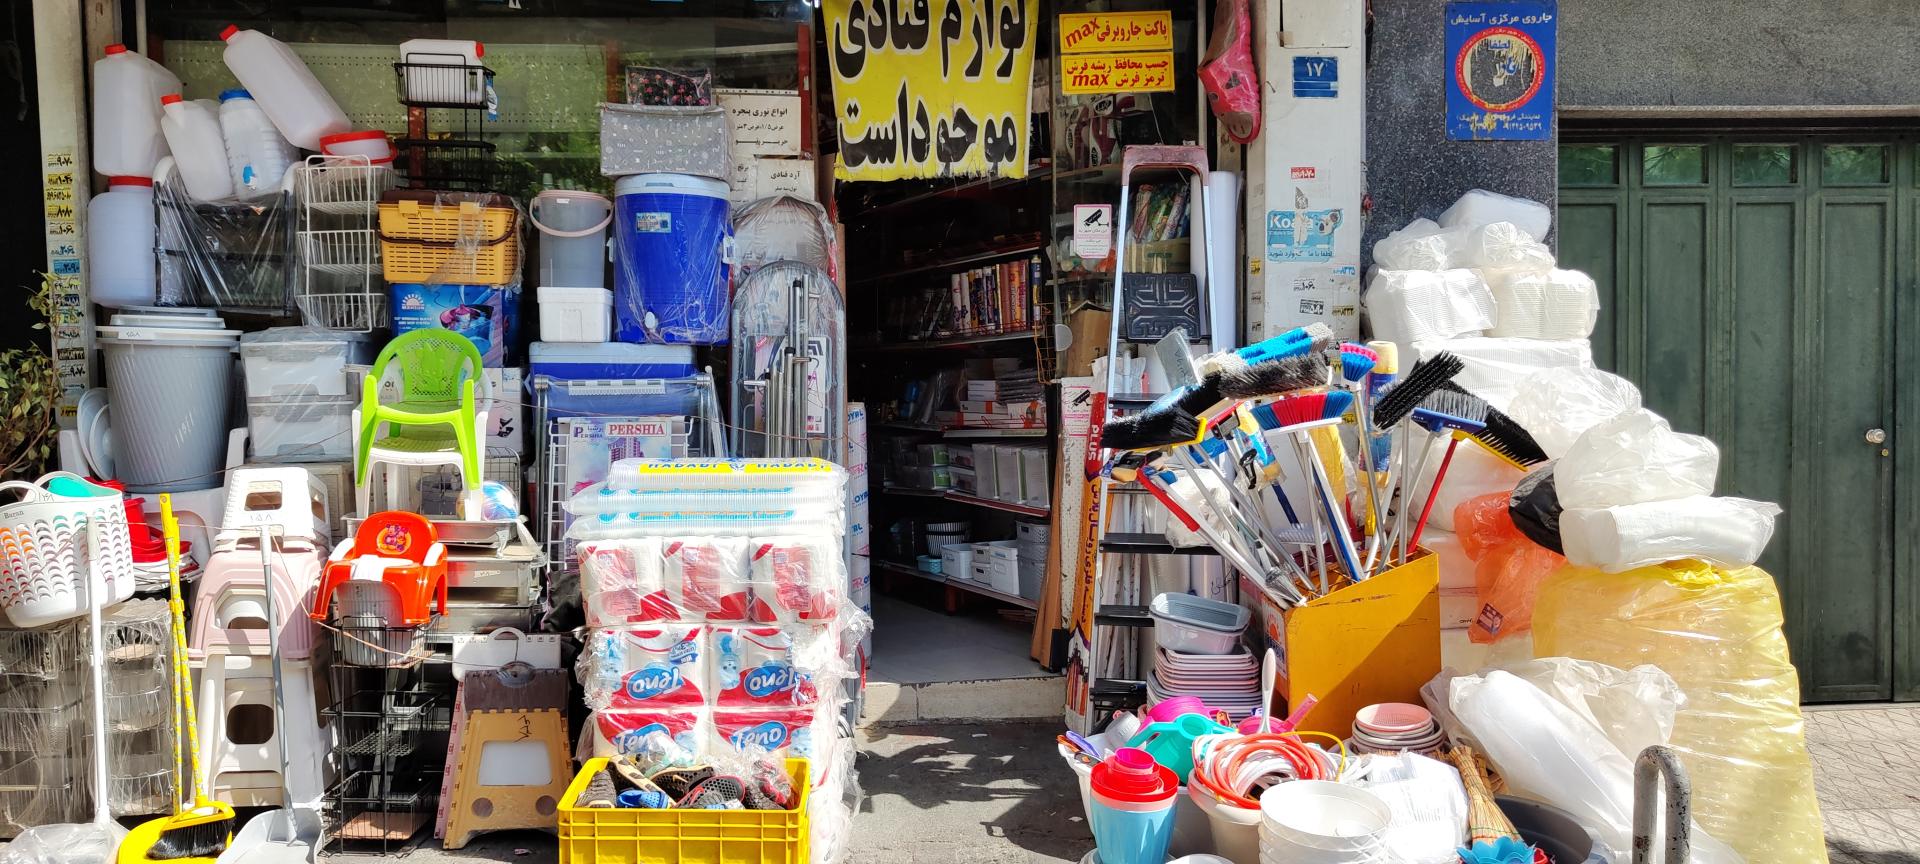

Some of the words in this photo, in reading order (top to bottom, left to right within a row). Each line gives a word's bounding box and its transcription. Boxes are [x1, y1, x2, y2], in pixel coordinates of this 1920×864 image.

[1450, 13, 1486, 25] آسایش
[1488, 13, 1520, 25] مرکزی
[1522, 13, 1553, 24] جاروی
[1065, 17, 1100, 47] max
[1144, 20, 1168, 40] پاکت
[1066, 59, 1089, 74] فرش
[1090, 61, 1112, 73] ریشه
[1114, 59, 1143, 70] محافظ
[1306, 62, 1324, 77] ۱۷
[1072, 73, 1109, 88] max
[1115, 72, 1141, 87] فرش
[1143, 72, 1165, 86] ترمز
[752, 107, 770, 117] توری
[771, 108, 788, 117] انواع
[789, 171, 801, 180] آرد
[608, 424, 665, 436] PERSHIA
[1088, 424, 1100, 461] PLUS
[3, 510, 24, 519] Baran
[632, 667, 684, 694] Teno
[749, 667, 797, 692] Teno
[733, 727, 782, 753] Teno
